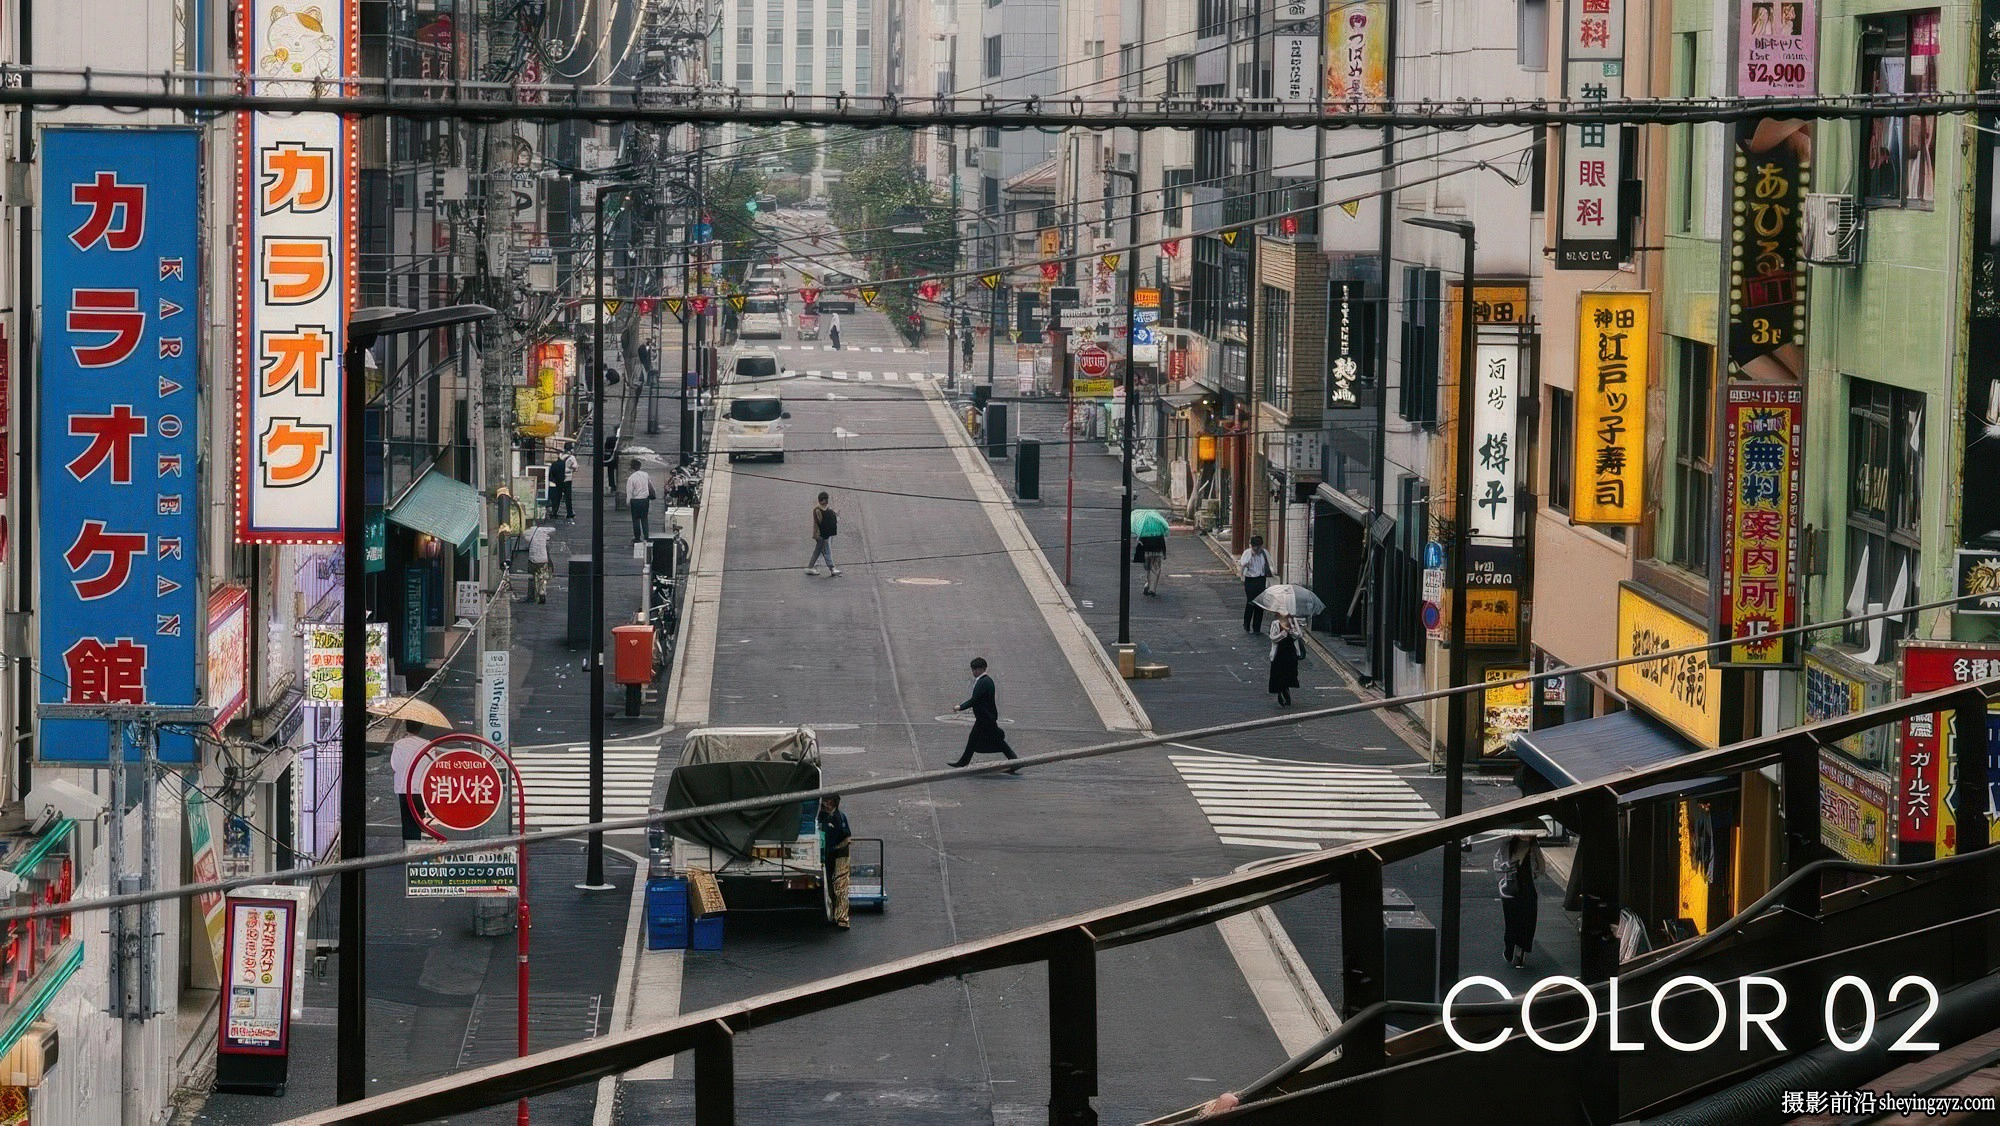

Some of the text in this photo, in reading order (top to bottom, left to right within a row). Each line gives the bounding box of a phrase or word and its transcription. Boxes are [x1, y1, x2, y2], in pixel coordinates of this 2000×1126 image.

[1750, 163, 1791, 275] あひる
[259, 141, 334, 488] カラオケ
[1594, 308, 1635, 328] 神田
[62, 171, 149, 704] カラオケ館
[430, 775, 495, 805] 消火栓
